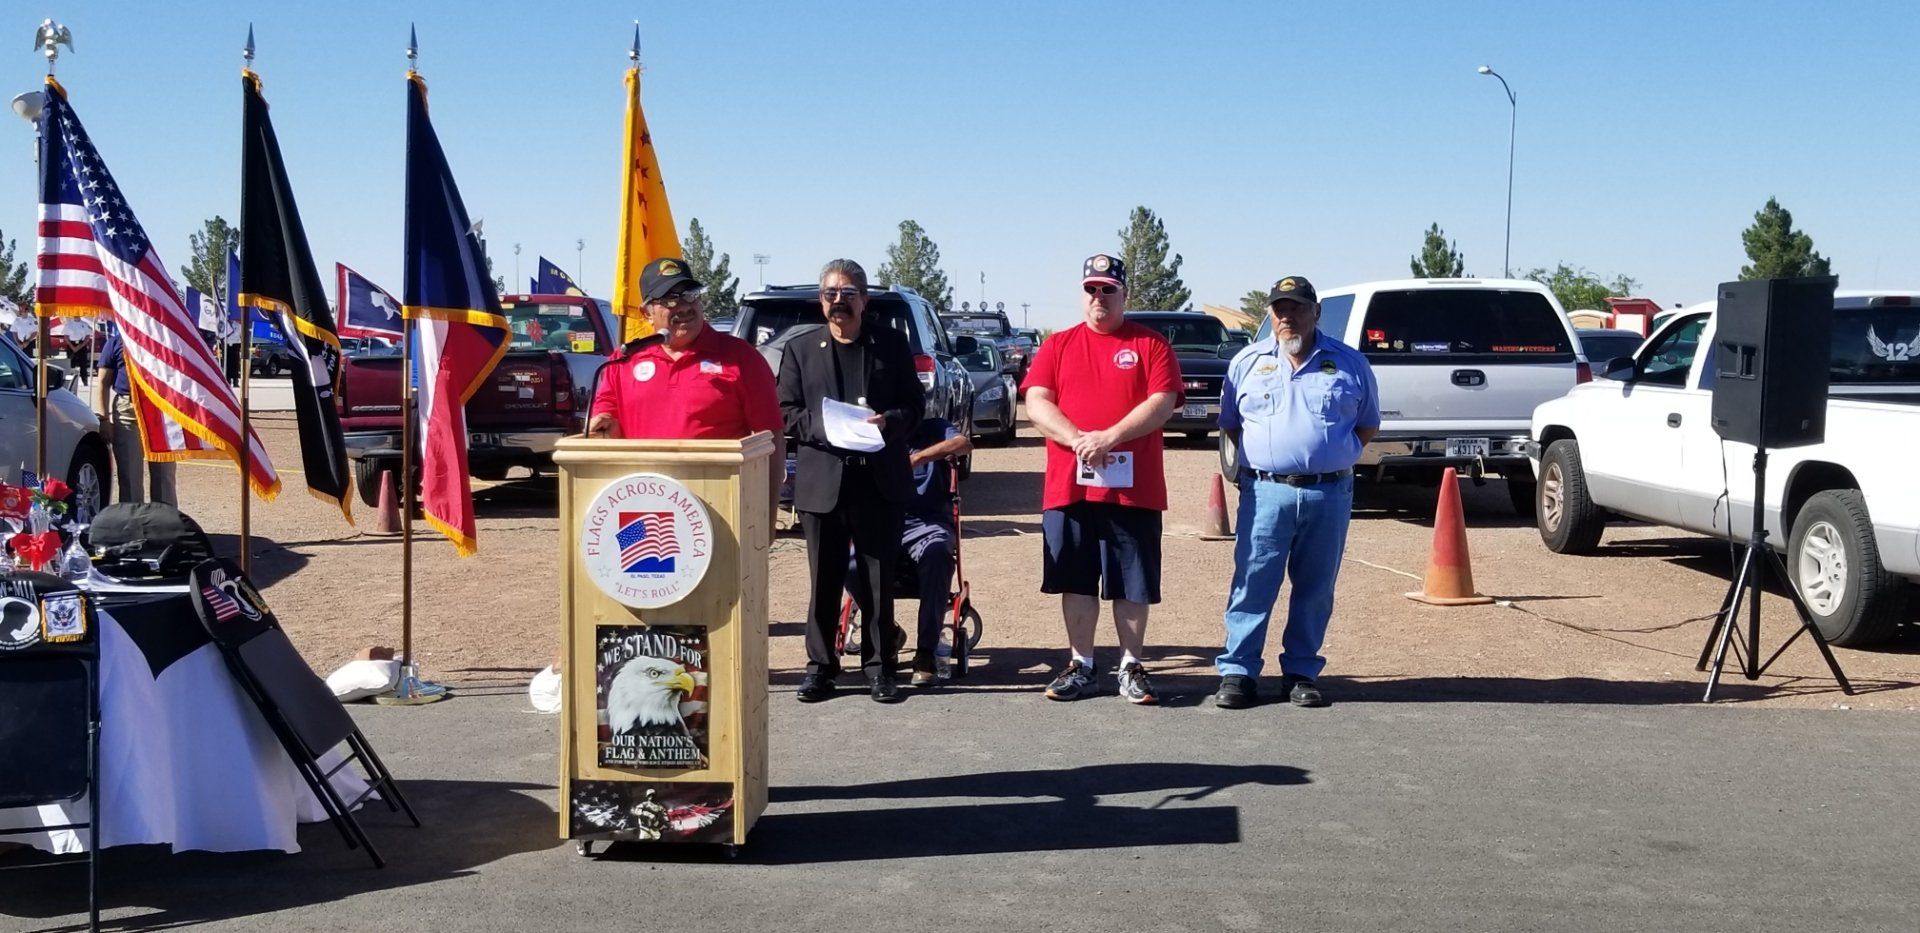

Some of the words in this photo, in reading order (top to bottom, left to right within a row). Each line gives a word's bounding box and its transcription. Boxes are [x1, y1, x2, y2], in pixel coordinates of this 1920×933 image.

[1886, 343, 1909, 361] 12
[587, 506, 609, 557] FLAGS
[607, 481, 666, 508] ACROSS
[668, 491, 707, 558] AMERICA
[12, 580, 38, 606] MIA
[603, 649, 621, 667] WE
[623, 634, 677, 660] STAND
[680, 646, 702, 668] FOR
[612, 735, 635, 747] OUR
[639, 735, 693, 748] NATION'S
[605, 747, 635, 759] FLAG
[638, 748, 646, 760] &
[649, 748, 700, 760] ANTHEM
